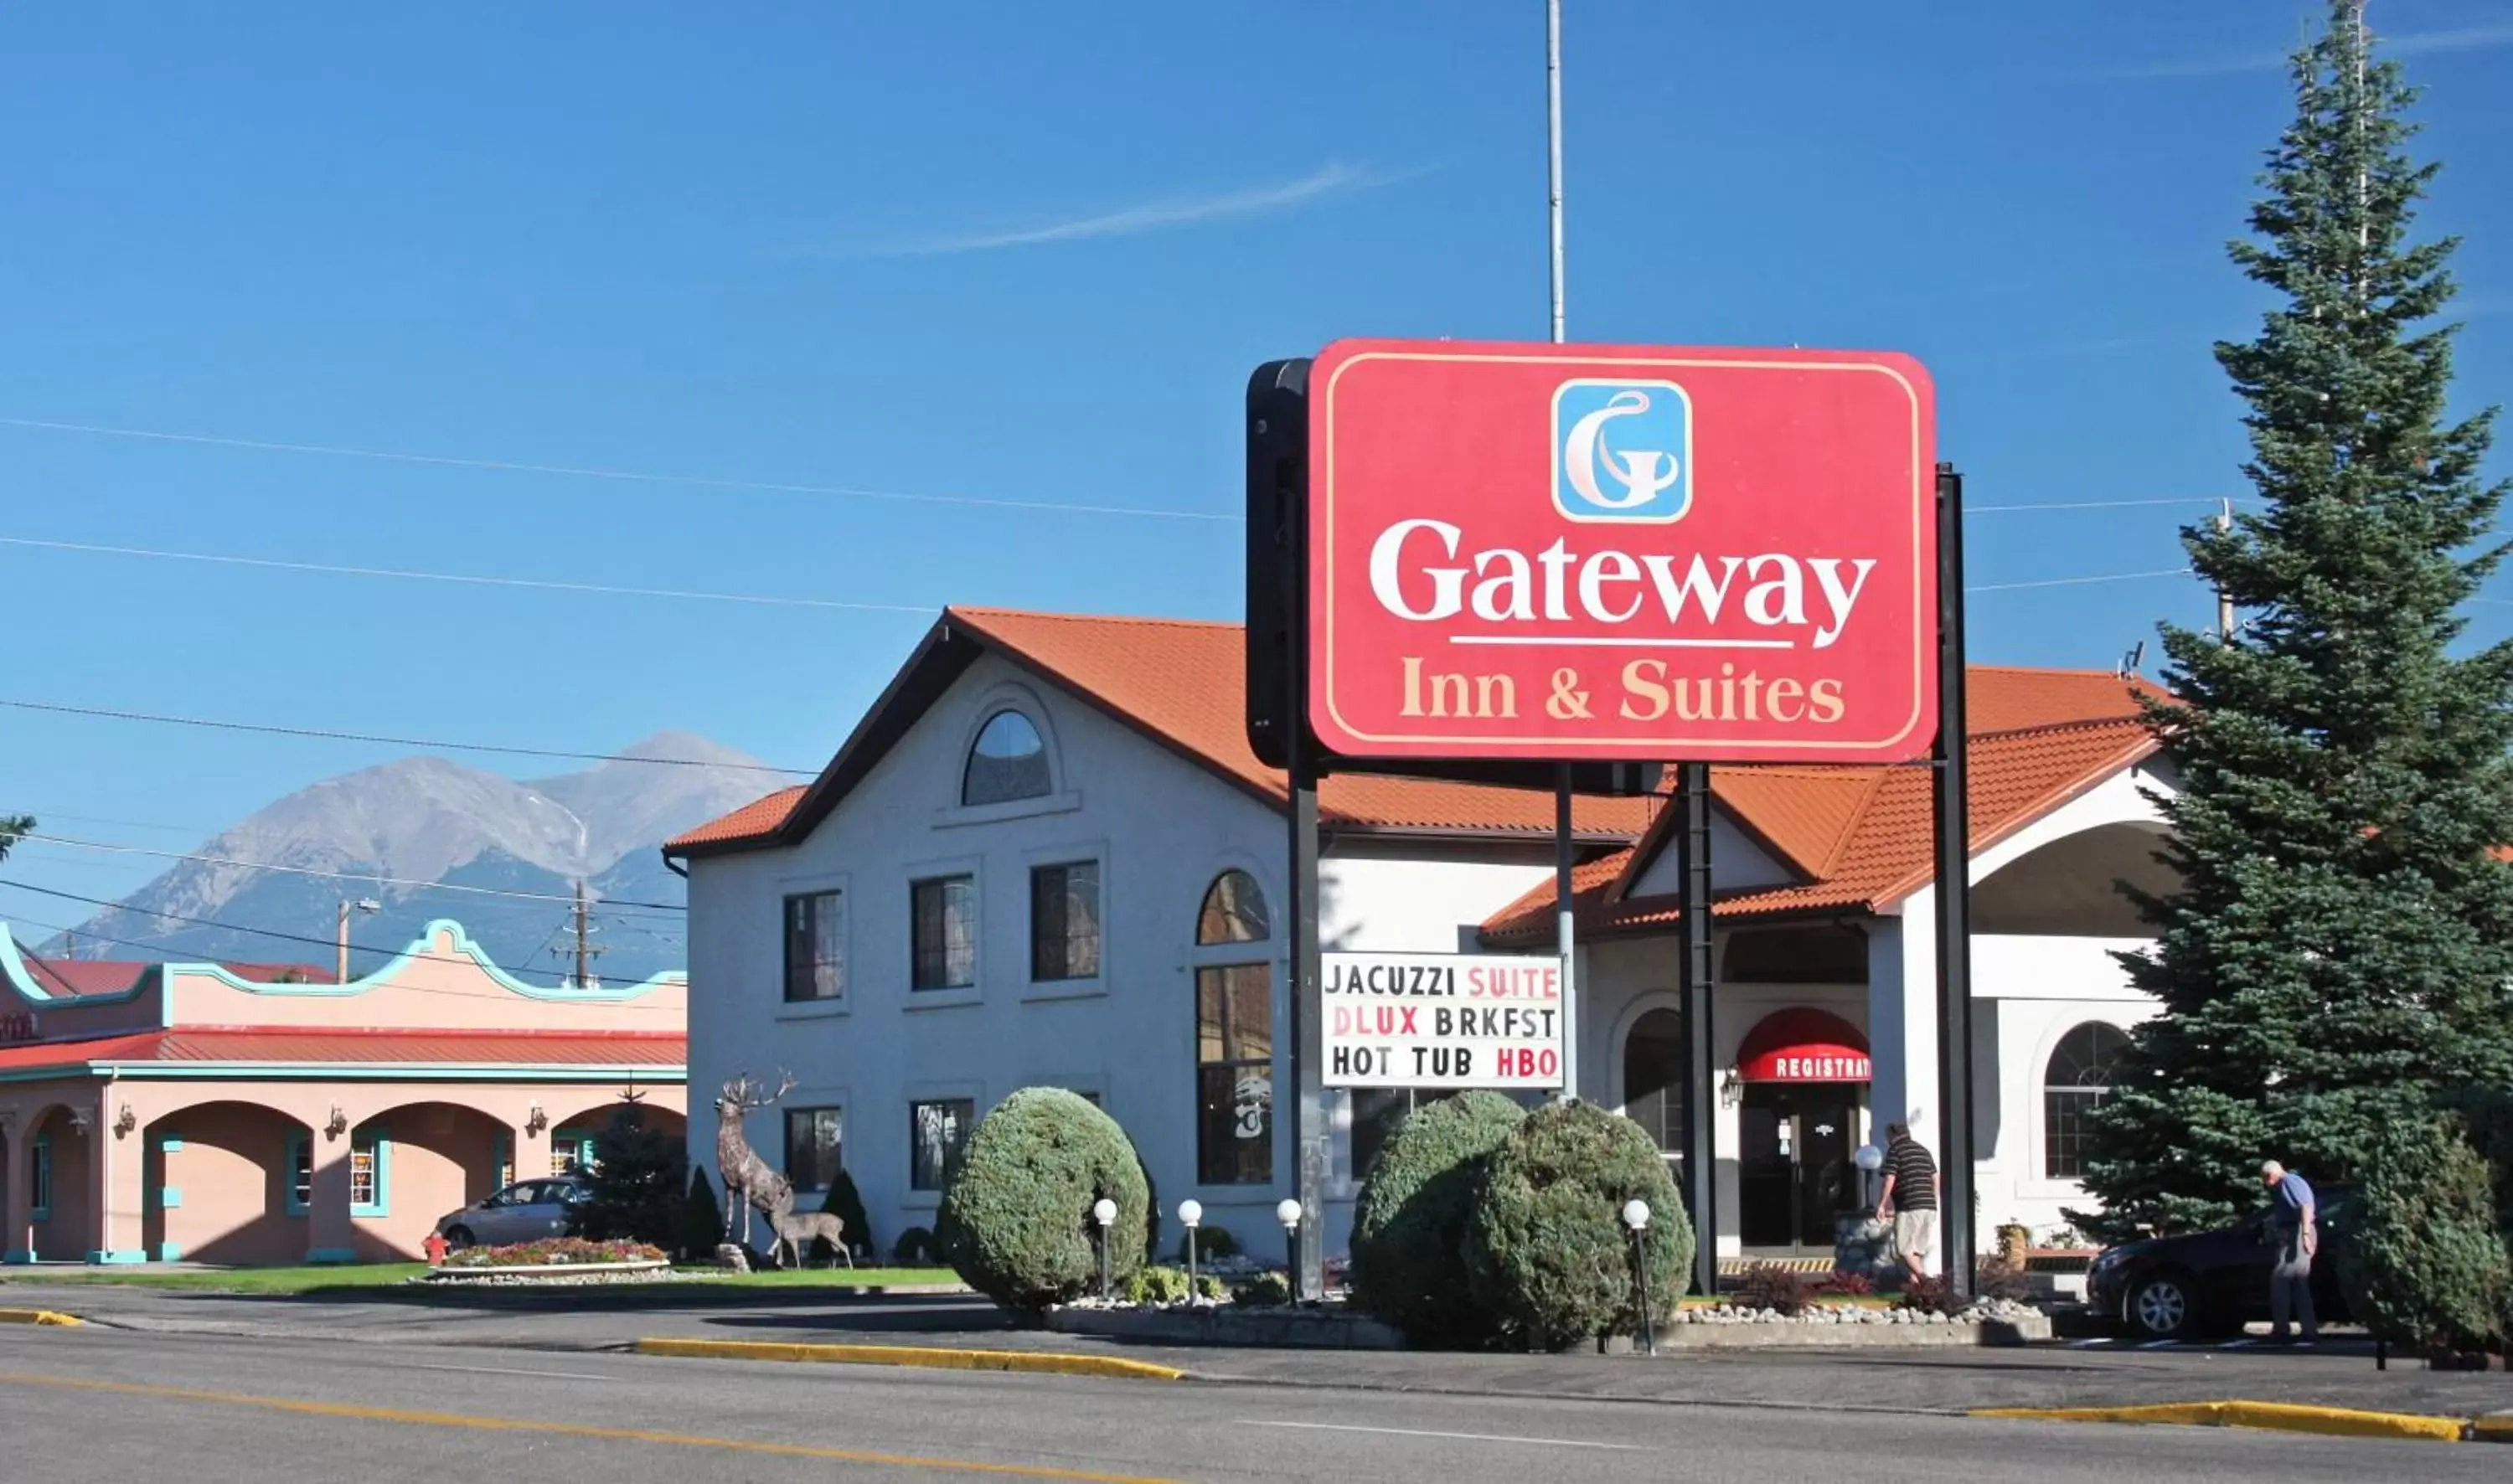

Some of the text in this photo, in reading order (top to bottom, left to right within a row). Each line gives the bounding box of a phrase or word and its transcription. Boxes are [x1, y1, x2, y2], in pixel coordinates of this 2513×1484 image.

[1369, 518, 1876, 648] Gateway
[1399, 657, 1845, 723] Inn & Suites
[1324, 965, 1557, 997] JACUZZI SUITE
[1334, 1005, 1556, 1038] DLUX BRKFST
[1333, 1046, 1557, 1078] HOT TUB HBO
